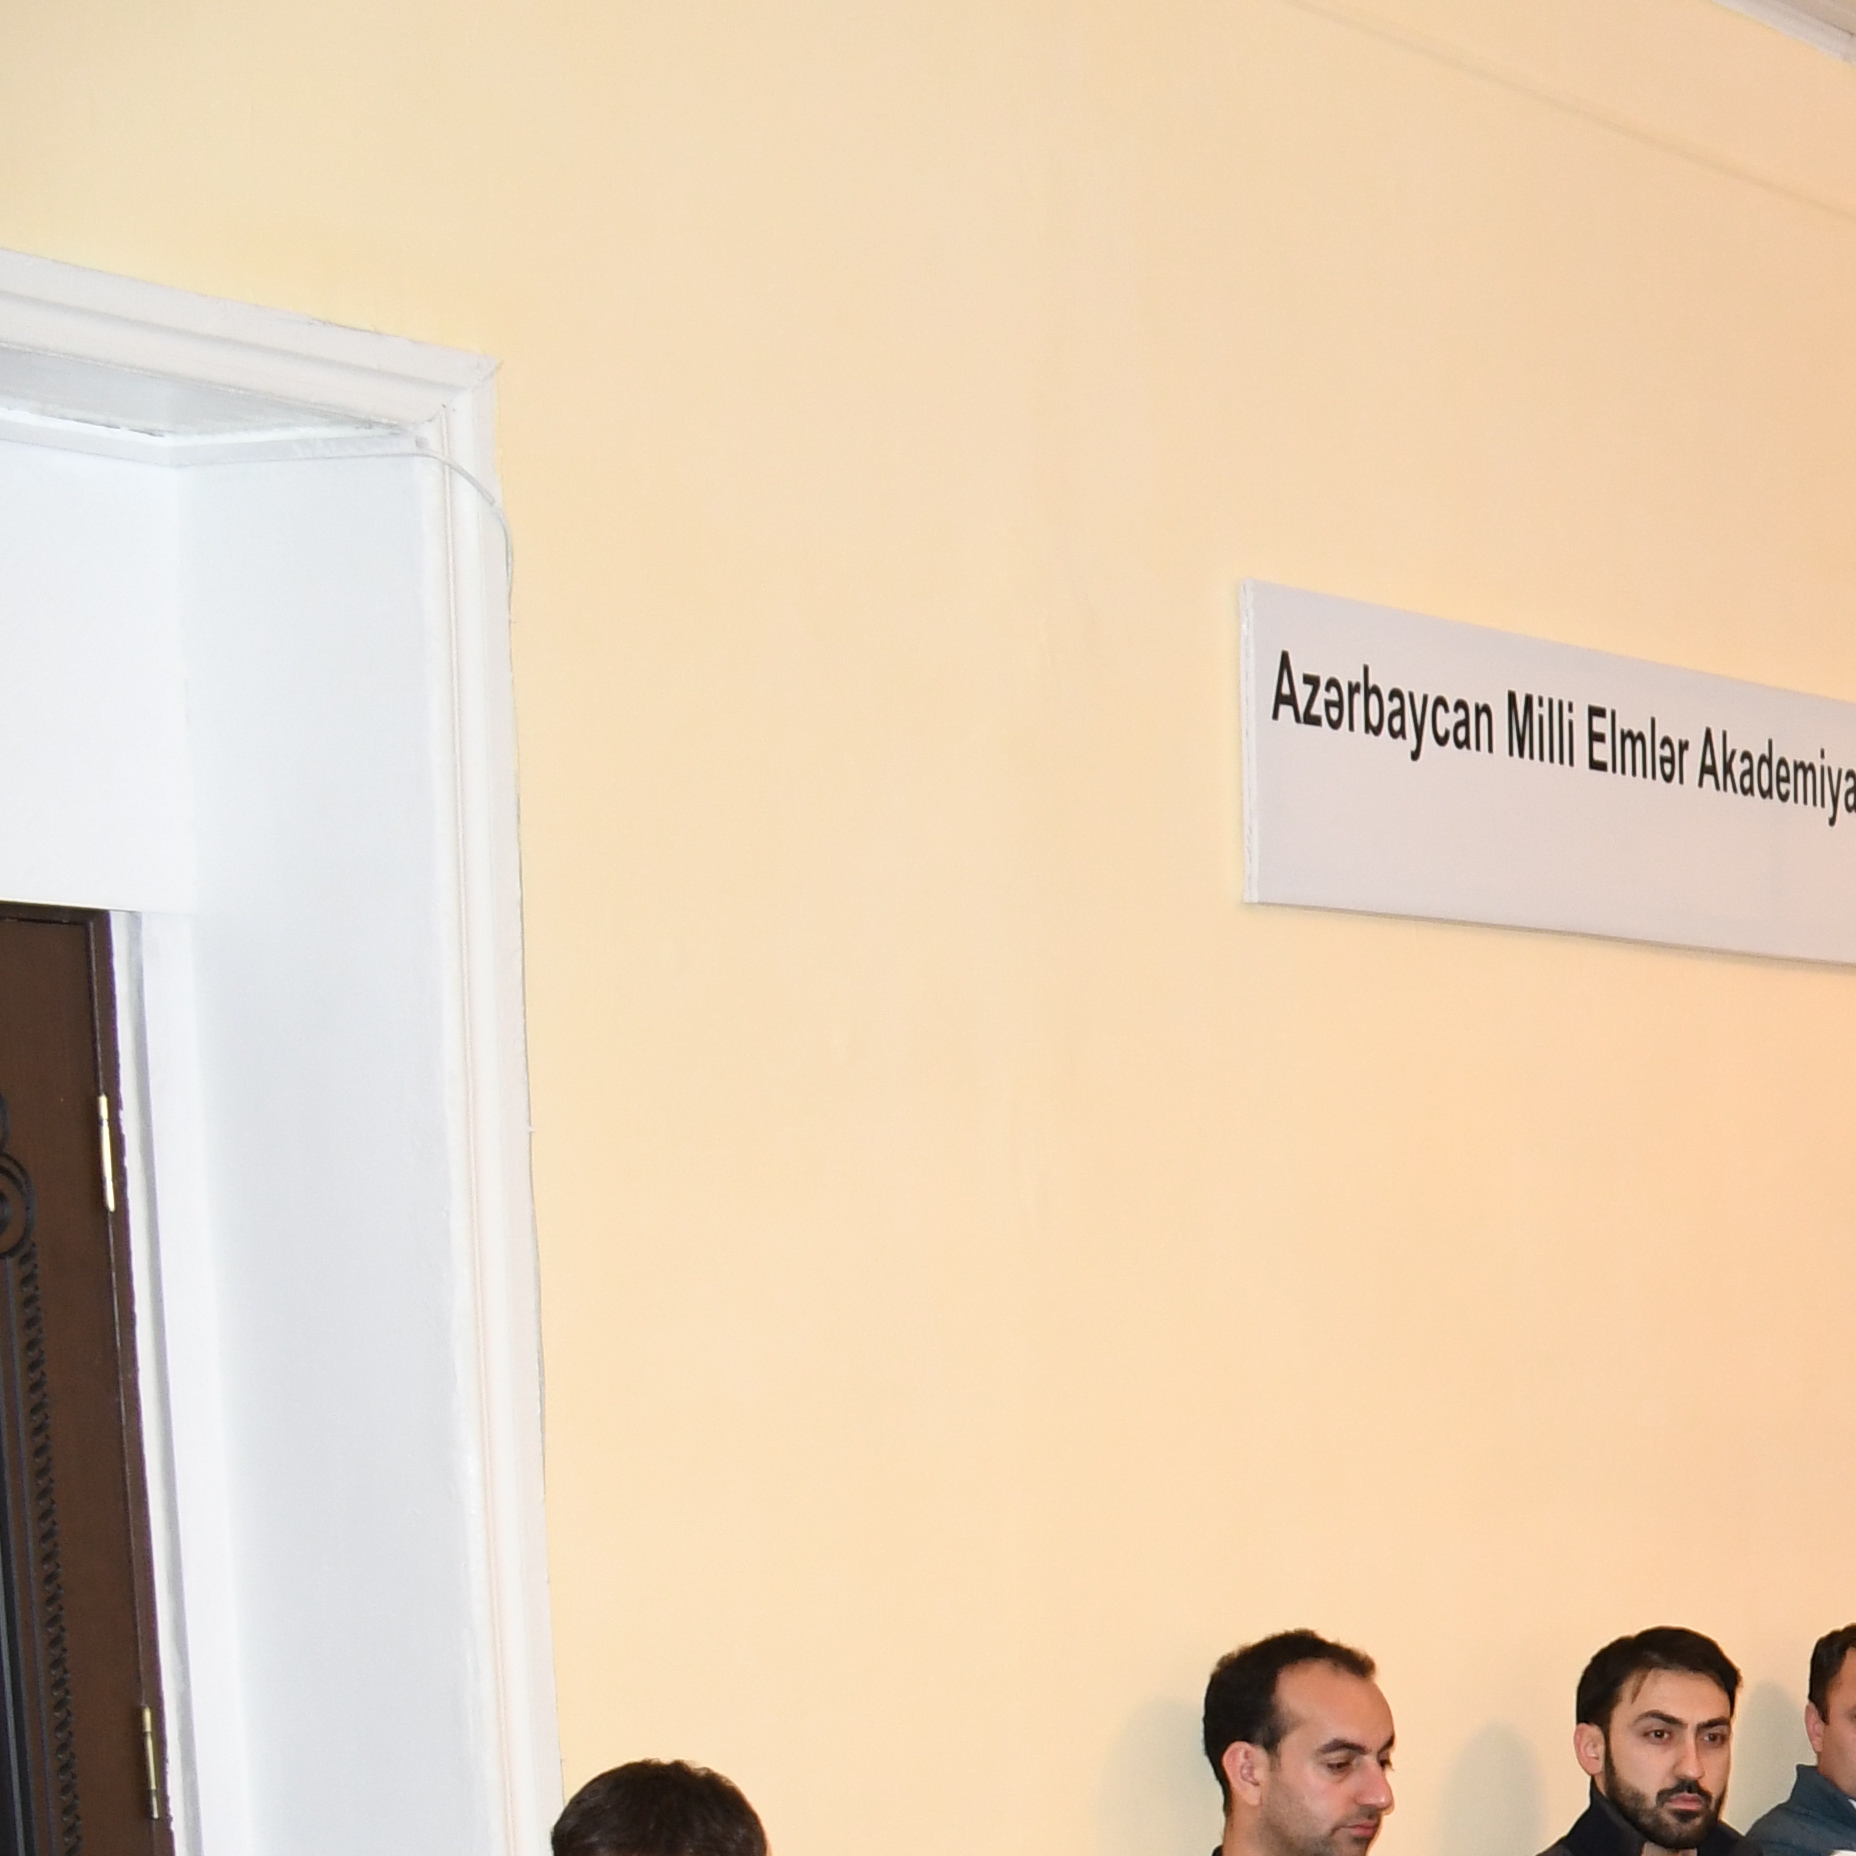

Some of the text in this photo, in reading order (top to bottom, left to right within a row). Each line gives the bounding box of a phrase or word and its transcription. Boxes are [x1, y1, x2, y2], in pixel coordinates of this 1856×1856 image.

[1272, 650, 1494, 762] Azərbaycan
[1507, 690, 1574, 767] Milli
[1587, 705, 1690, 785] Elmlər
